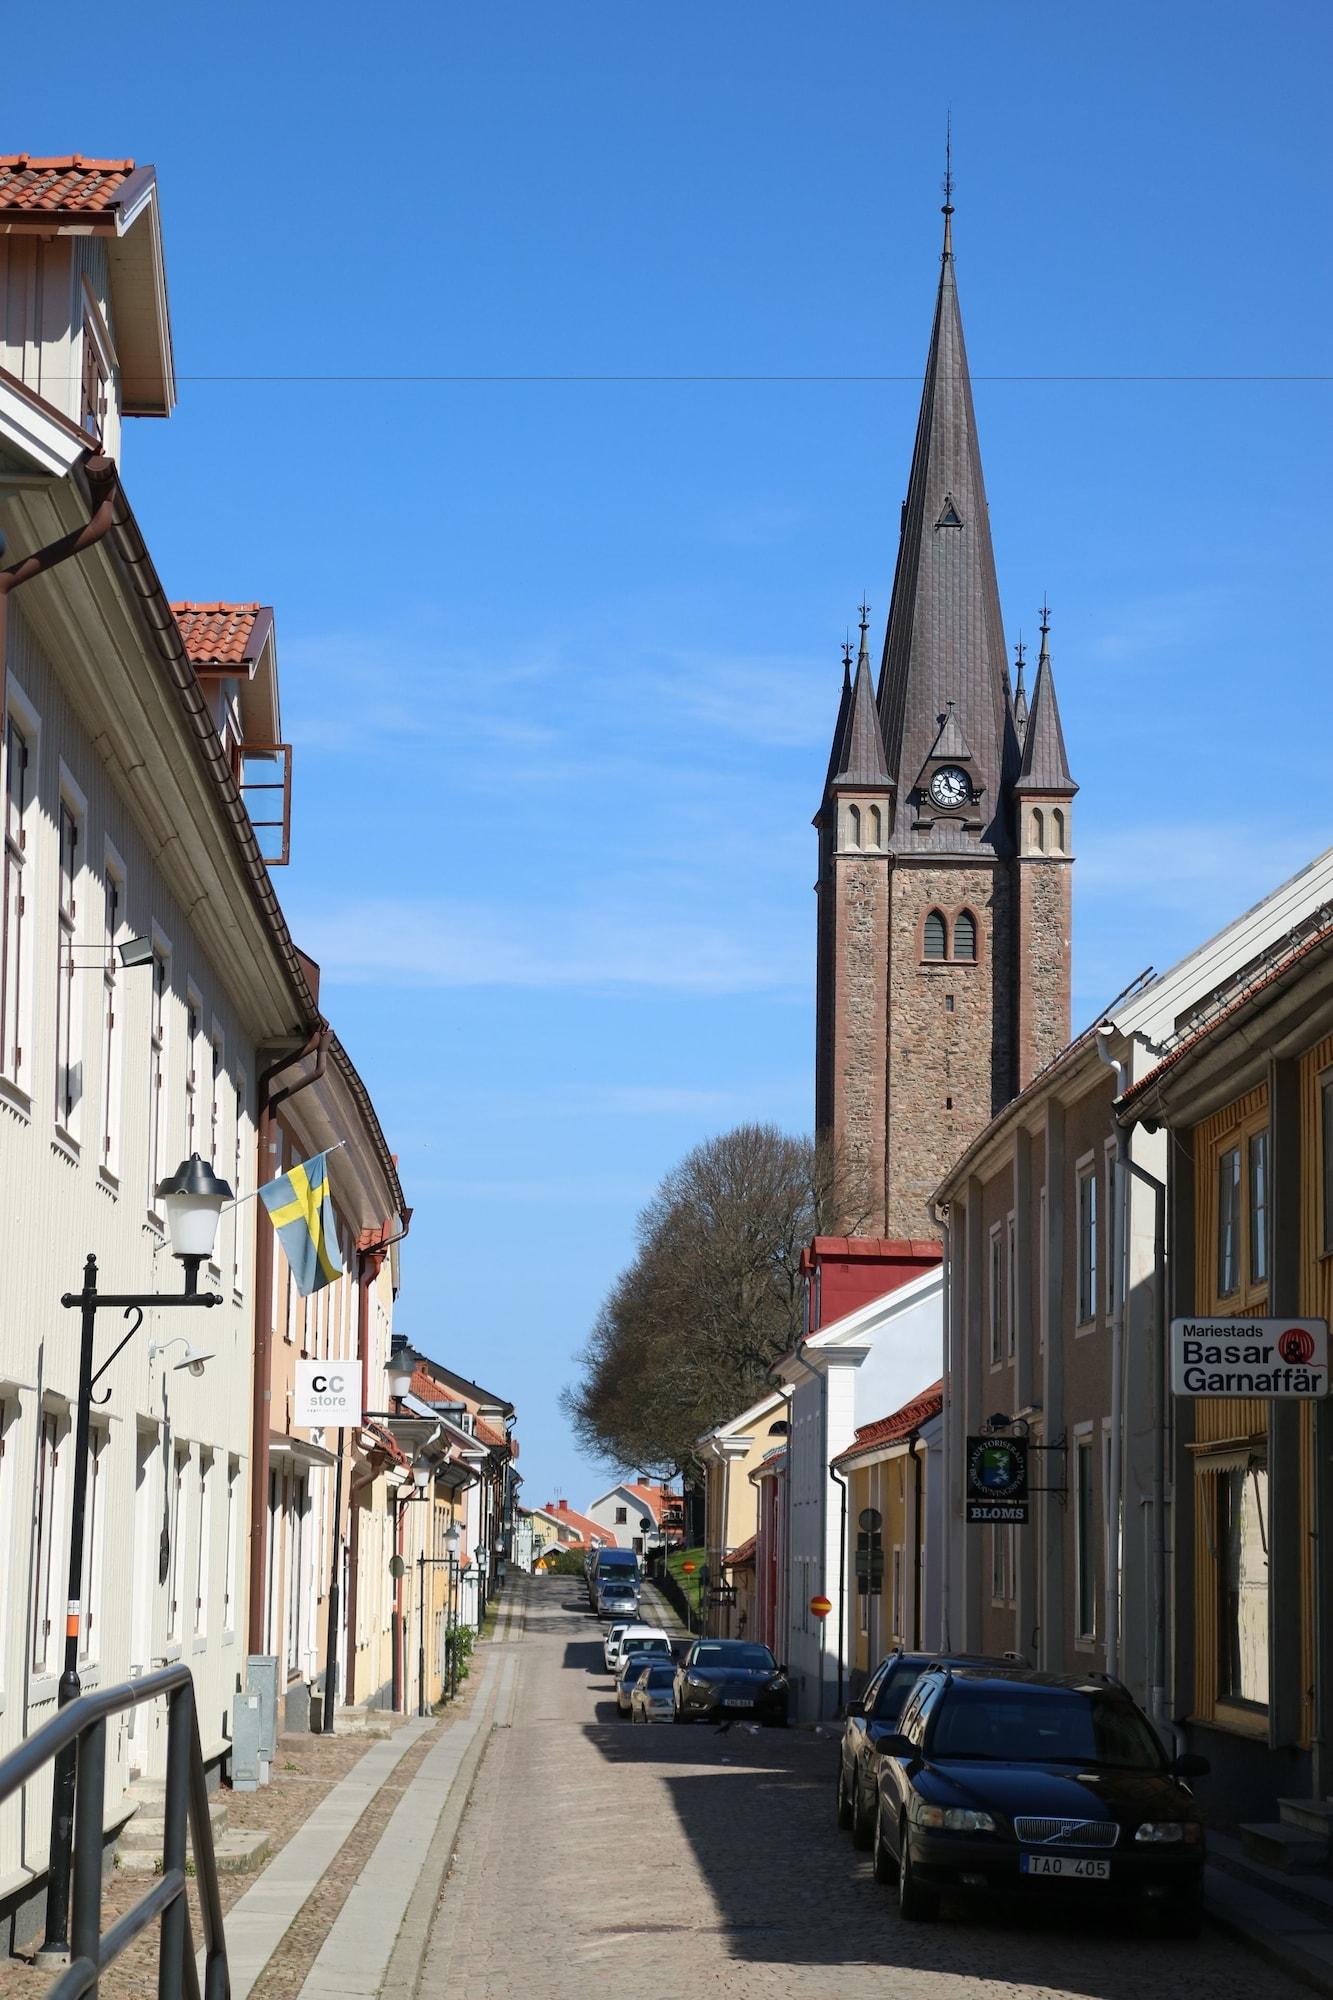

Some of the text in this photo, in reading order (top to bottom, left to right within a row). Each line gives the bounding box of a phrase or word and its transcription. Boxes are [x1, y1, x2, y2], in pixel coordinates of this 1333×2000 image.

[1183, 1325, 1263, 1337] Mariestads
[1183, 1341, 1274, 1364] Basar
[312, 1376, 344, 1393] CC
[1183, 1367, 1322, 1392] Garnaffär
[310, 1396, 346, 1406] store
[971, 1507, 1024, 1519] BLOMS
[1032, 1857, 1106, 1876] TAO 405
